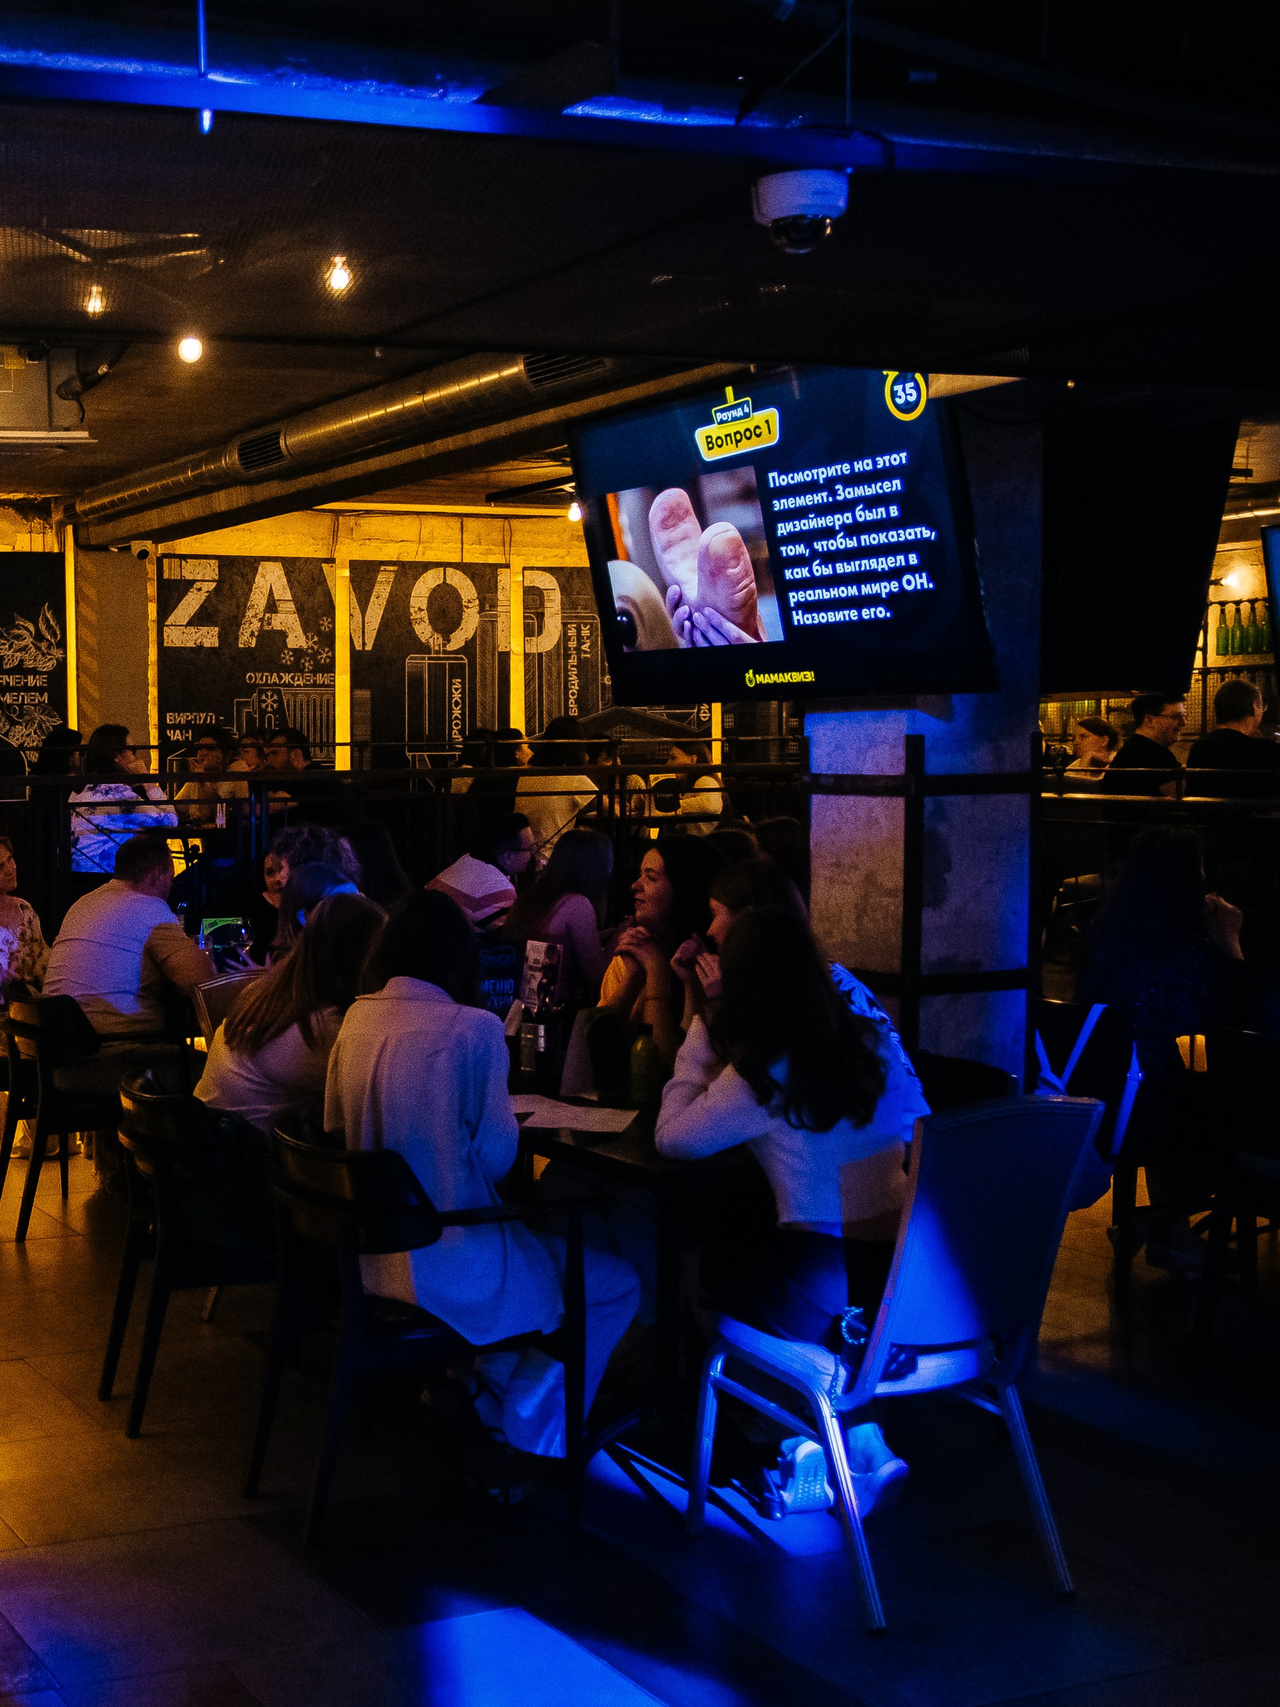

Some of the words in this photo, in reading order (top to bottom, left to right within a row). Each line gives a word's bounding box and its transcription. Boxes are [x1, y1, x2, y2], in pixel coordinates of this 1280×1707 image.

[893, 382, 917, 404] 35
[715, 408, 743, 422] Раунд
[743, 404, 750, 414] 4
[705, 423, 763, 451] Вопрос
[765, 419, 772, 435] 1
[768, 463, 851, 488] Посмотрите
[854, 459, 873, 473] на
[876, 452, 907, 469] этот
[772, 491, 833, 511] элемент.
[835, 479, 902, 501] Замысел
[776, 512, 853, 537] дизайнера
[855, 504, 886, 522] был
[889, 505, 899, 517] в
[780, 543, 810, 557] том,
[813, 532, 858, 552] чтобы
[860, 526, 936, 547] показать,
[784, 566, 811, 580] как
[812, 559, 833, 576] бы
[836, 555, 906, 574] выглядел
[908, 553, 918, 566] в
[163, 558, 562, 652] ZAVOD
[788, 585, 859, 607] реальном
[861, 580, 899, 598] мире
[902, 573, 934, 591] ОН.
[792, 609, 859, 625] Назовите
[862, 606, 891, 620] его.
[580, 623, 591, 660] ТАНК
[245, 672, 335, 687] ОХЛАЖДЕНИЕ
[755, 670, 815, 684] МАМАКВИЗ!
[166, 729, 193, 742] ЧАН
